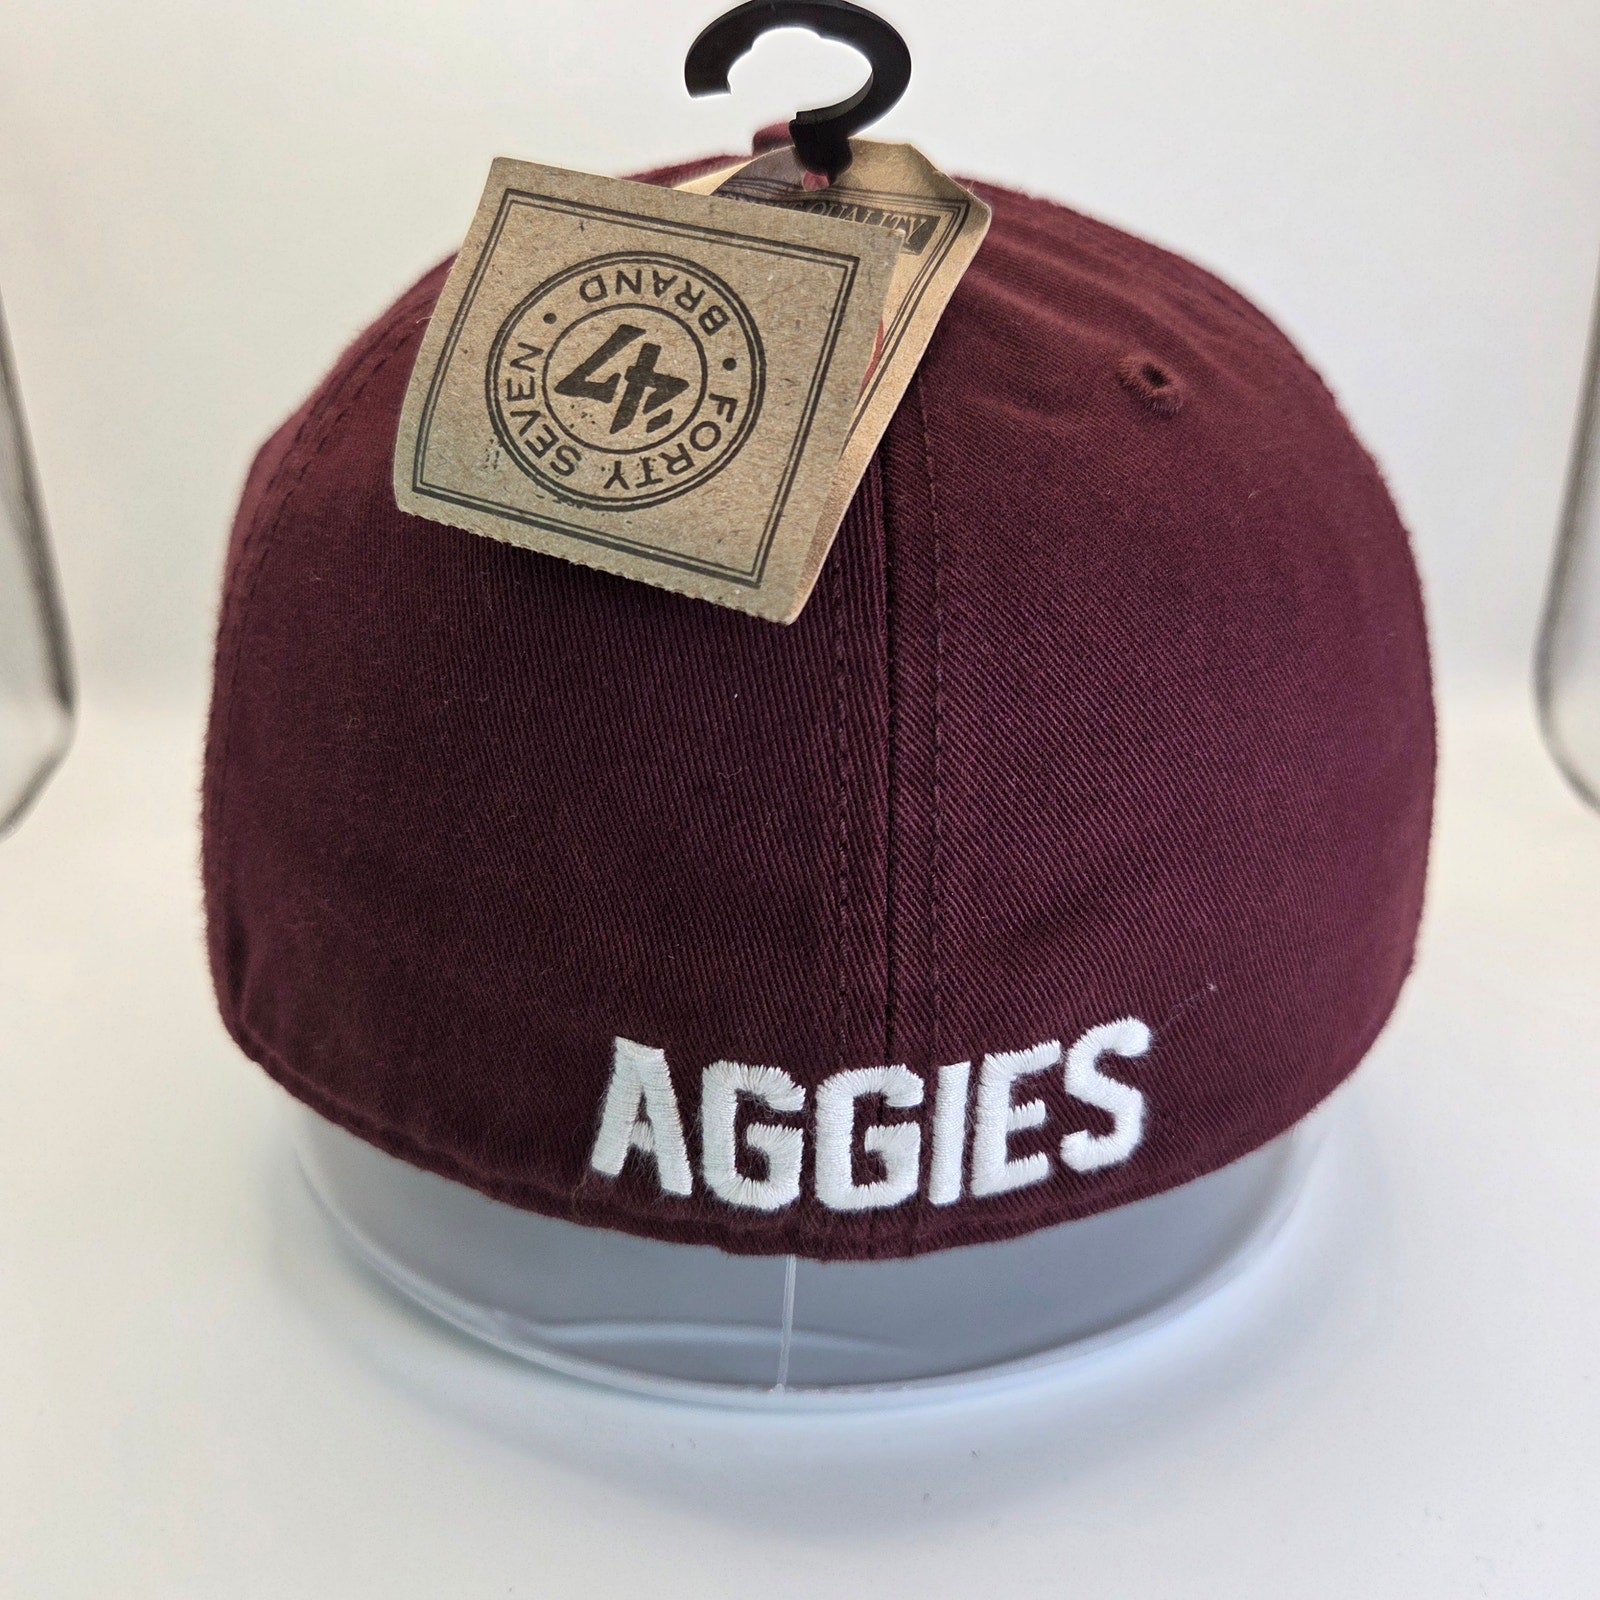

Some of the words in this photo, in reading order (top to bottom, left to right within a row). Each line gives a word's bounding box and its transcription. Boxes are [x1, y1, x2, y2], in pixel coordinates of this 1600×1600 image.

[579, 270, 730, 336] BRAND
[507, 342, 582, 476] SEVEN
[603, 393, 738, 490] FORTY
[591, 1016, 1152, 1211] AGGIES
